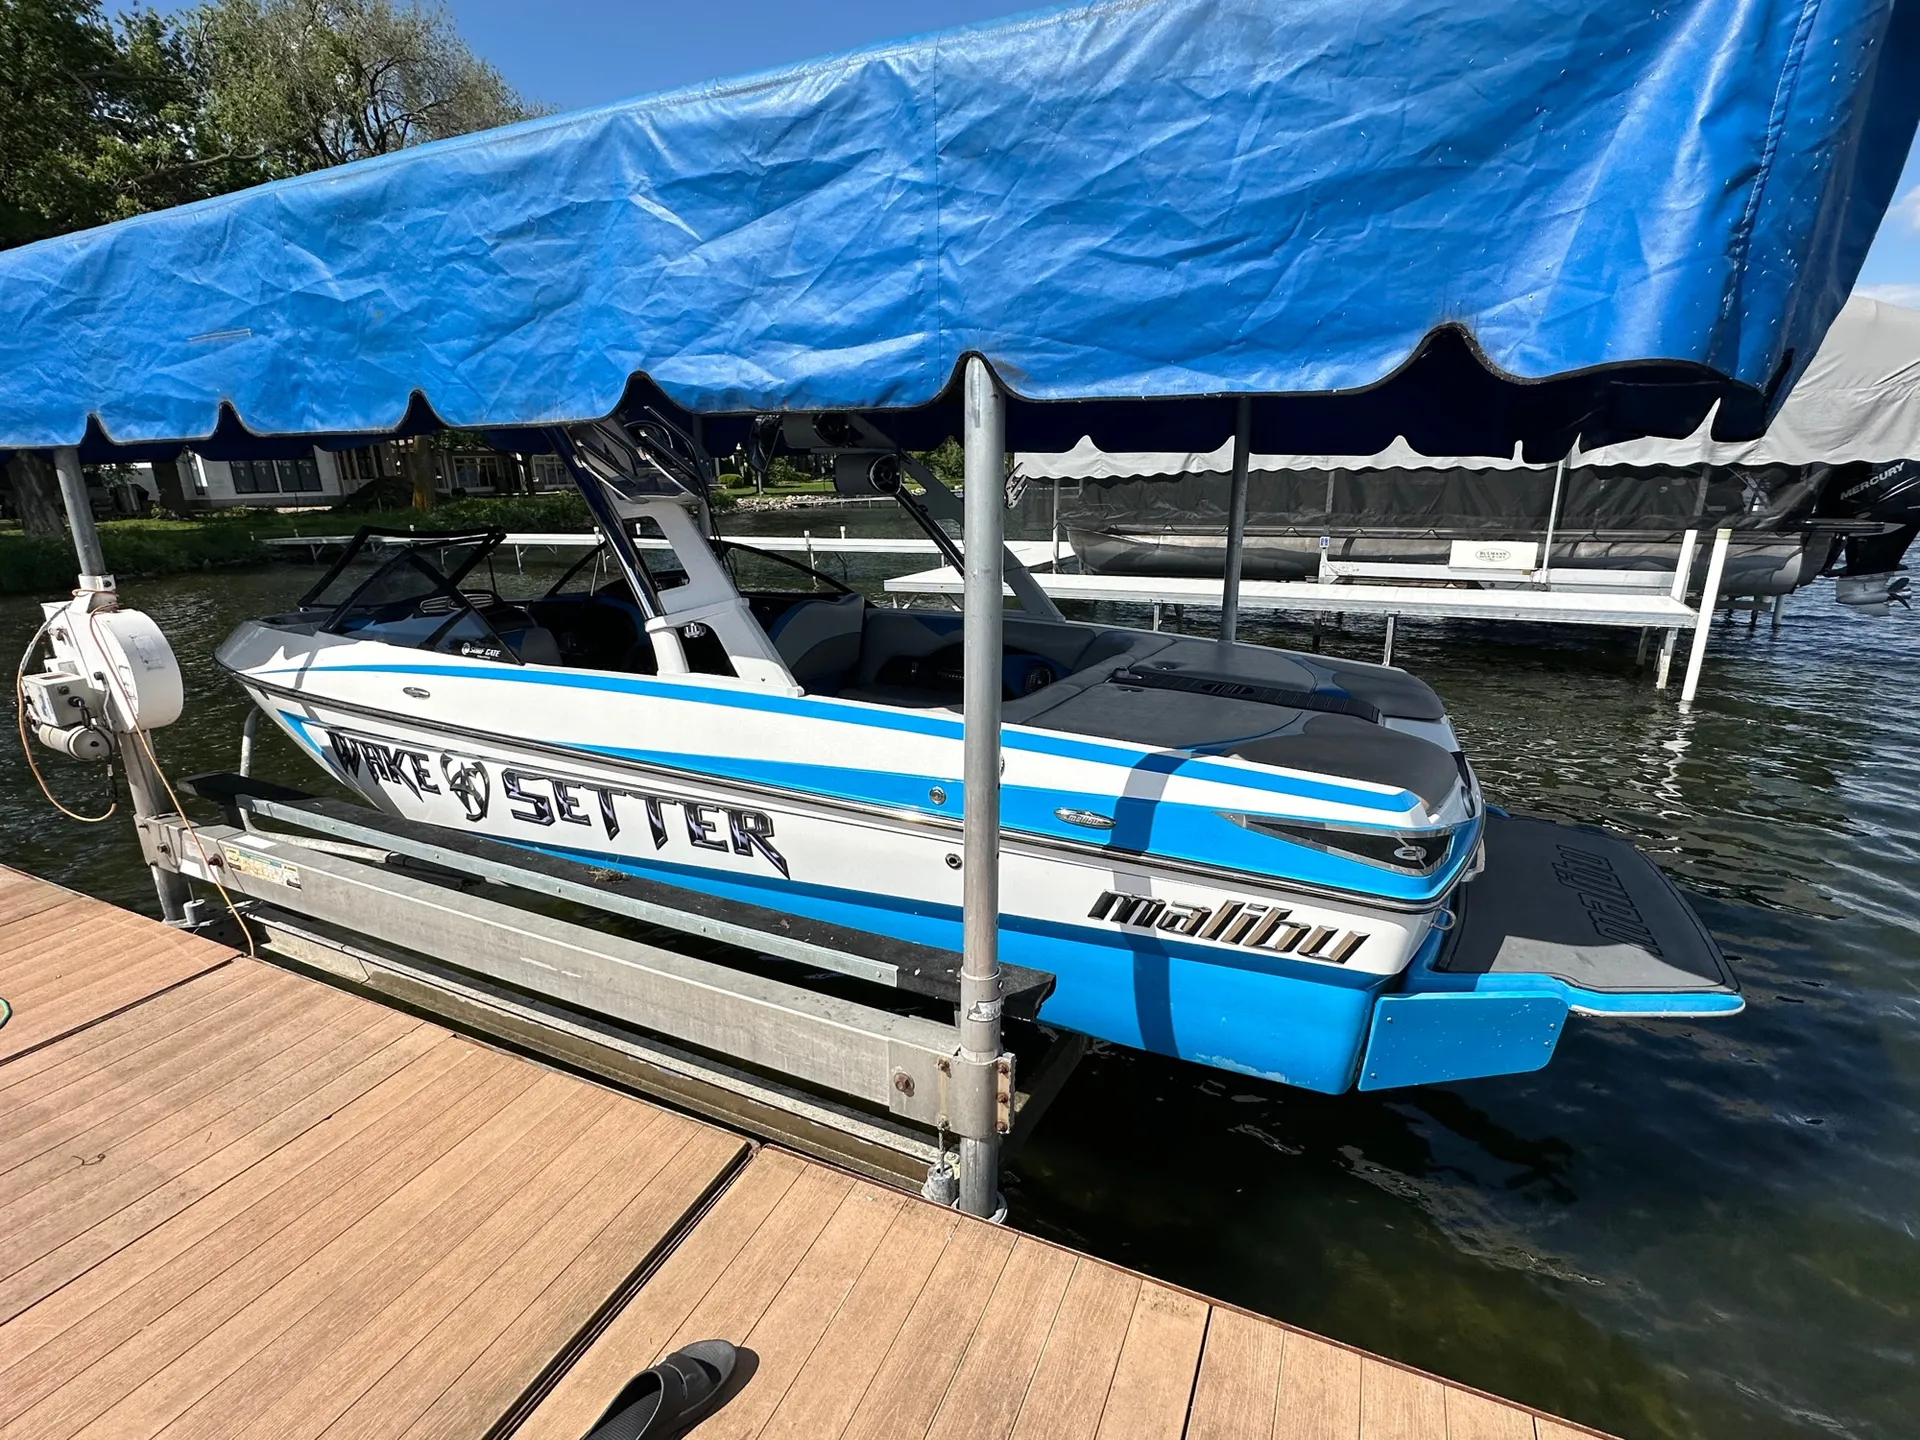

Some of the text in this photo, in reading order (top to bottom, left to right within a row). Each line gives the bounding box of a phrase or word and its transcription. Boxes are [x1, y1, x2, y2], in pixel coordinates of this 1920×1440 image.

[1840, 461, 1905, 500] MERCURY
[325, 730, 790, 880] WAKE SETTER
[1087, 889, 1371, 965] malibu
[1552, 844, 1664, 957] malibu
